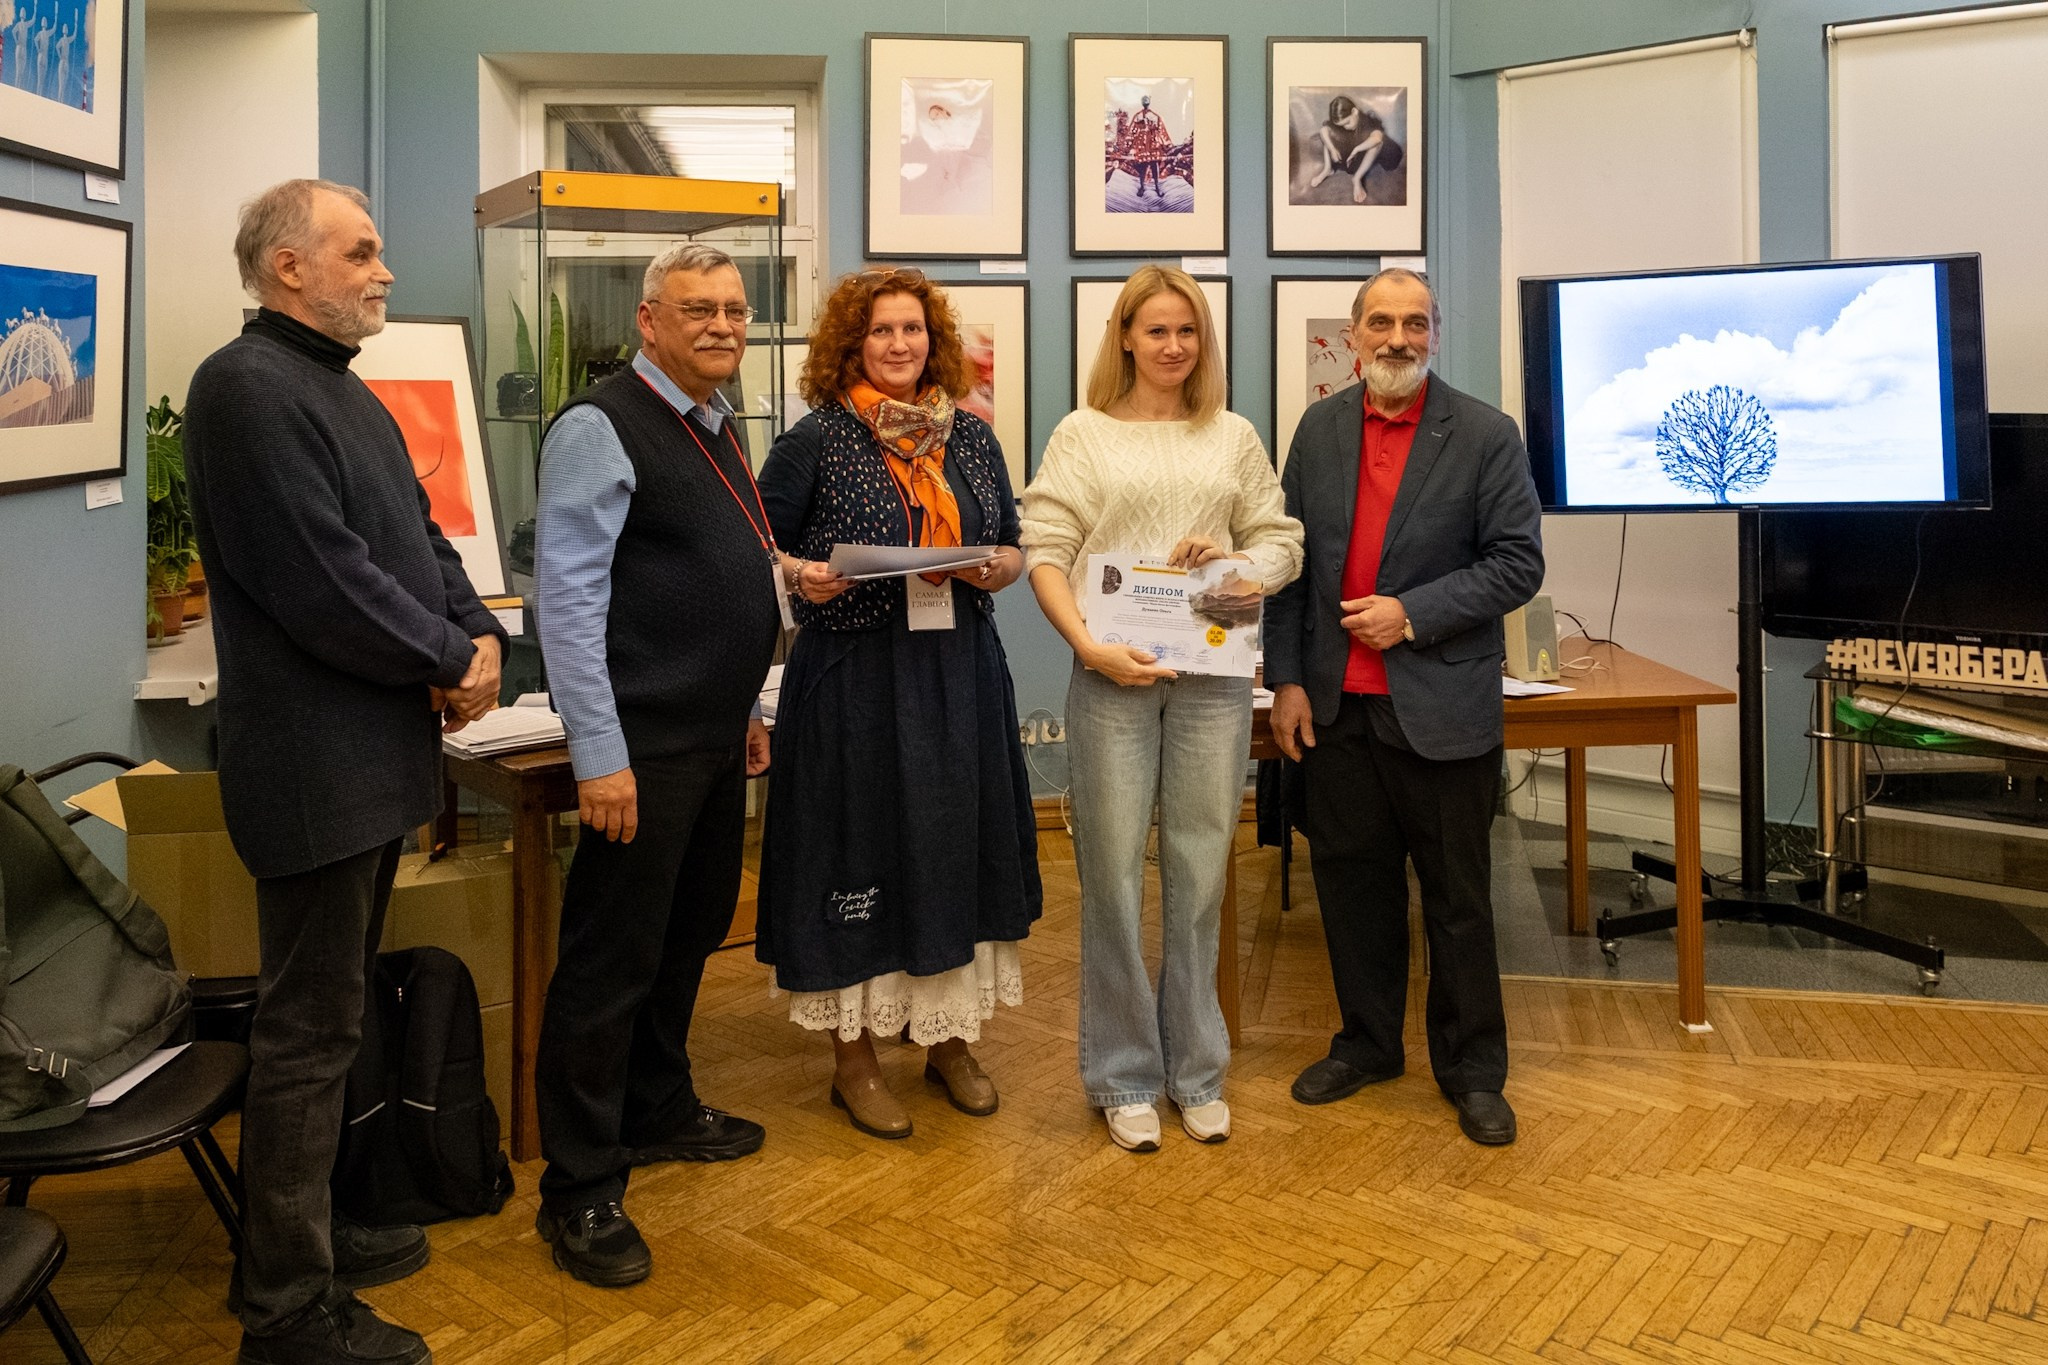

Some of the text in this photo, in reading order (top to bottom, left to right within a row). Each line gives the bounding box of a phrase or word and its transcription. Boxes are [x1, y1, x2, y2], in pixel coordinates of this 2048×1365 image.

[915, 591, 945, 599] САМАЯ
[1132, 585, 1184, 597] ДИПЛОМ
[911, 600, 949, 608] ГЛАВНАЯ
